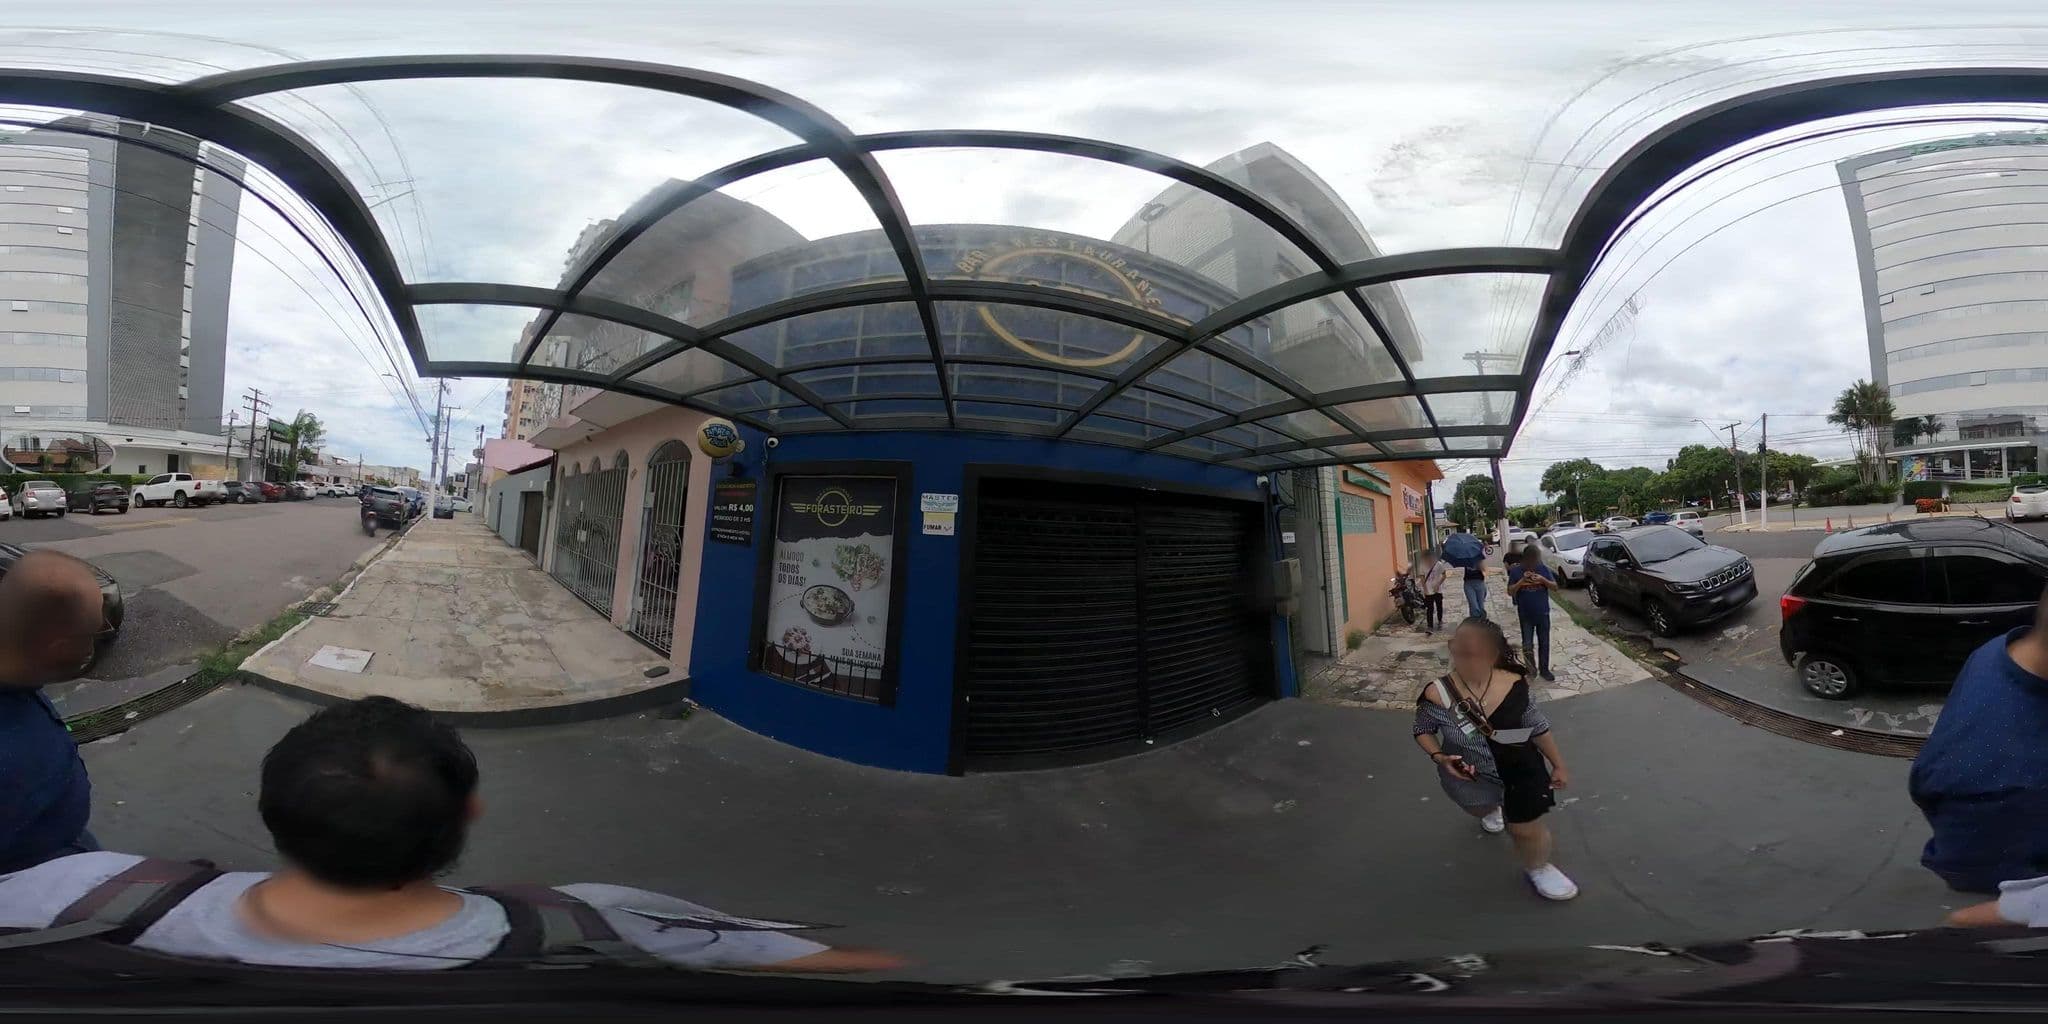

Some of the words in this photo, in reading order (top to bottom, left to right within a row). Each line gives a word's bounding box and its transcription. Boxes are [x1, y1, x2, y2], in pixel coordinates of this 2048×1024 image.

[956, 250, 986, 273] BAR
[728, 503, 738, 512] R$
[739, 504, 754, 513] 4,00
[806, 503, 863, 516] FORASTEIRO
[779, 562, 800, 574] TODOS
[778, 573, 788, 584] OS
[788, 575, 806, 587] DIAS!
[842, 648, 854, 657] SUA
[855, 650, 881, 662] SEMANA
